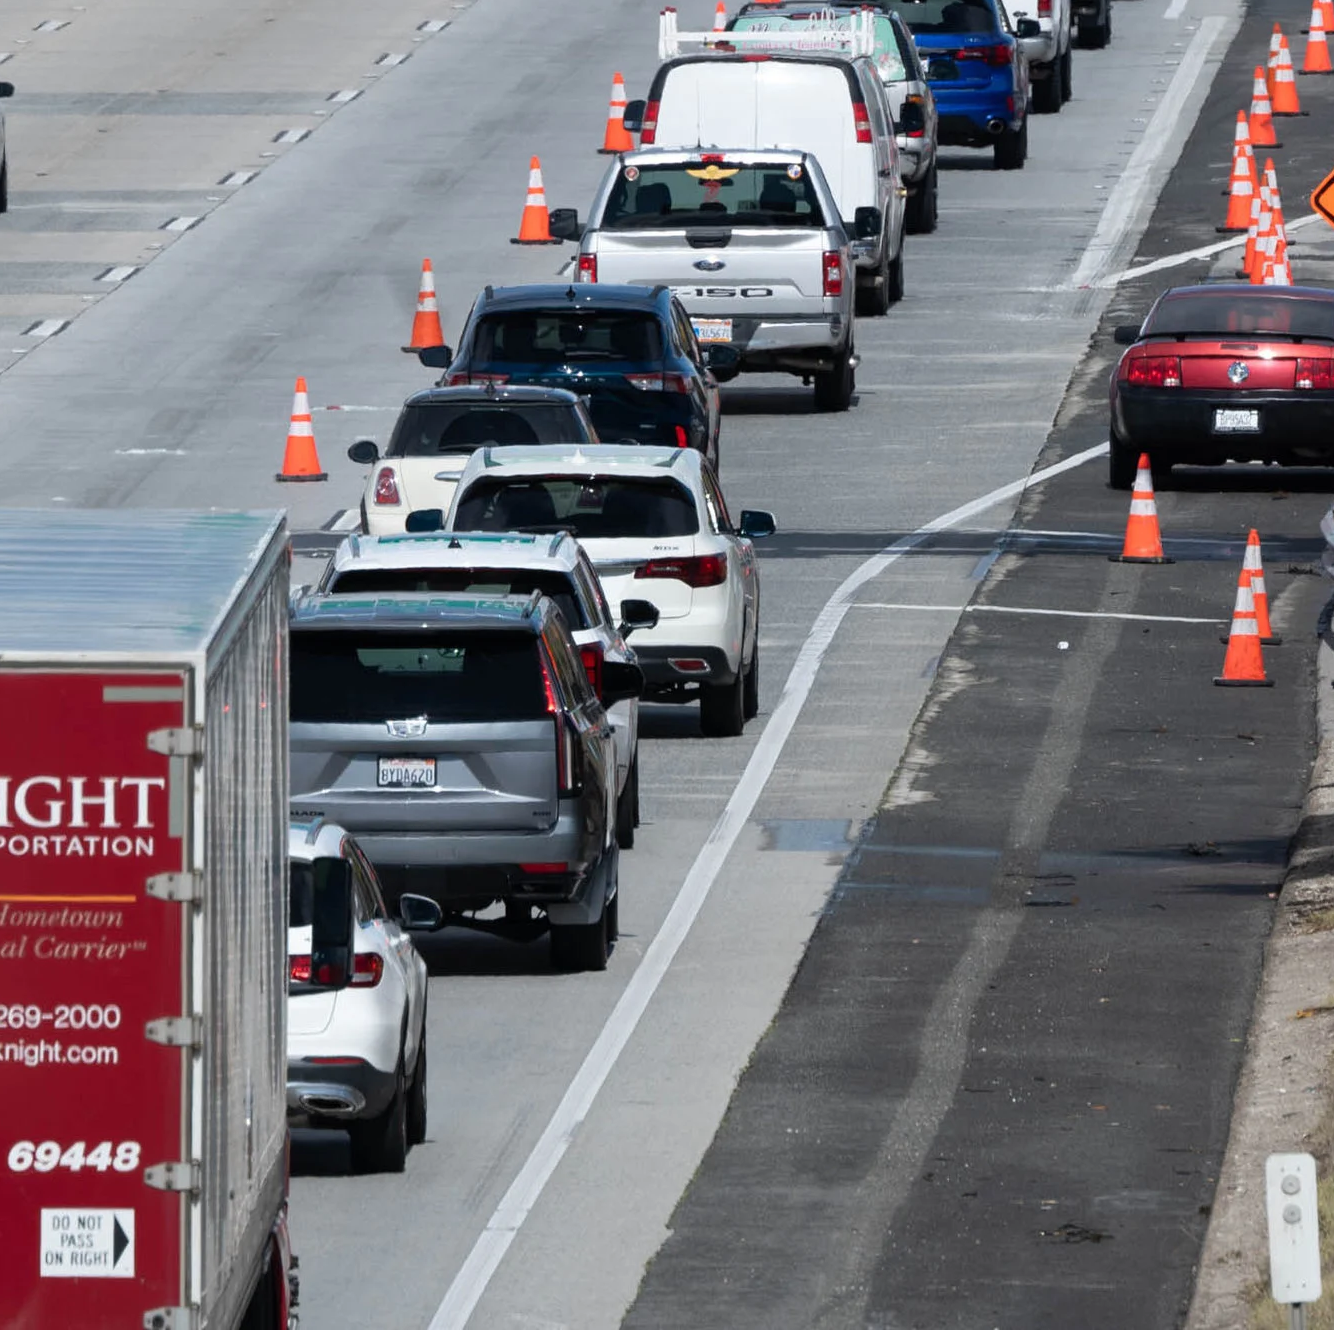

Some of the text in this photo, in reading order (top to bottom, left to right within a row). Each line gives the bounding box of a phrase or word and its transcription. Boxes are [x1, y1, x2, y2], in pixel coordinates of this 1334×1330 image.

[7, 1140, 141, 1172] 69448
[52, 1215, 103, 1230] DO NOT
[60, 1233, 94, 1249] PASS
[45, 1251, 109, 1266] ON RIGHT
